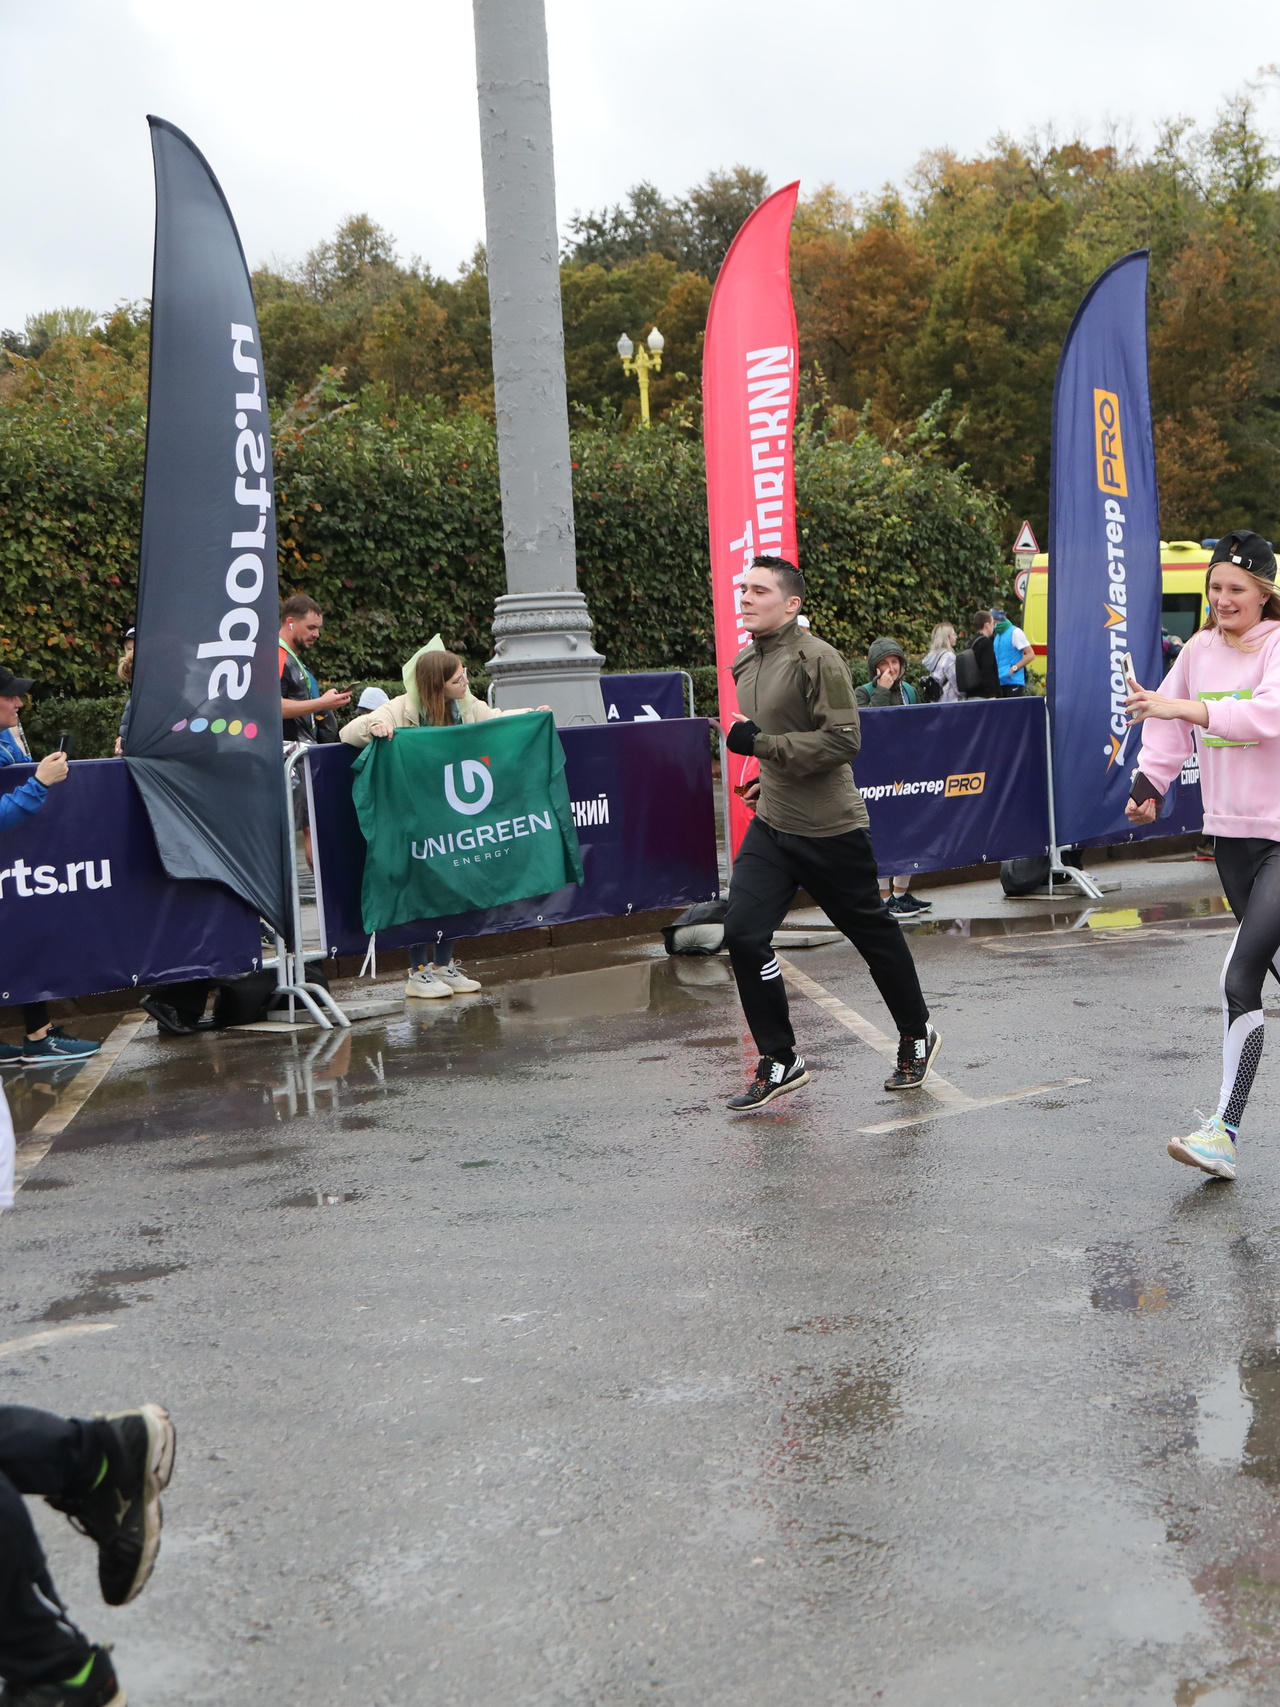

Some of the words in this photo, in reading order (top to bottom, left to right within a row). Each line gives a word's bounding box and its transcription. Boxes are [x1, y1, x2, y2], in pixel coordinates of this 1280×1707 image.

[1100, 397, 1121, 490] PRO
[858, 779, 944, 801] портМастер
[948, 776, 982, 793] PRO
[1181, 769, 1199, 785] СПОР
[411, 810, 552, 860] UNIGREEN
[453, 847, 510, 867] ENERGY
